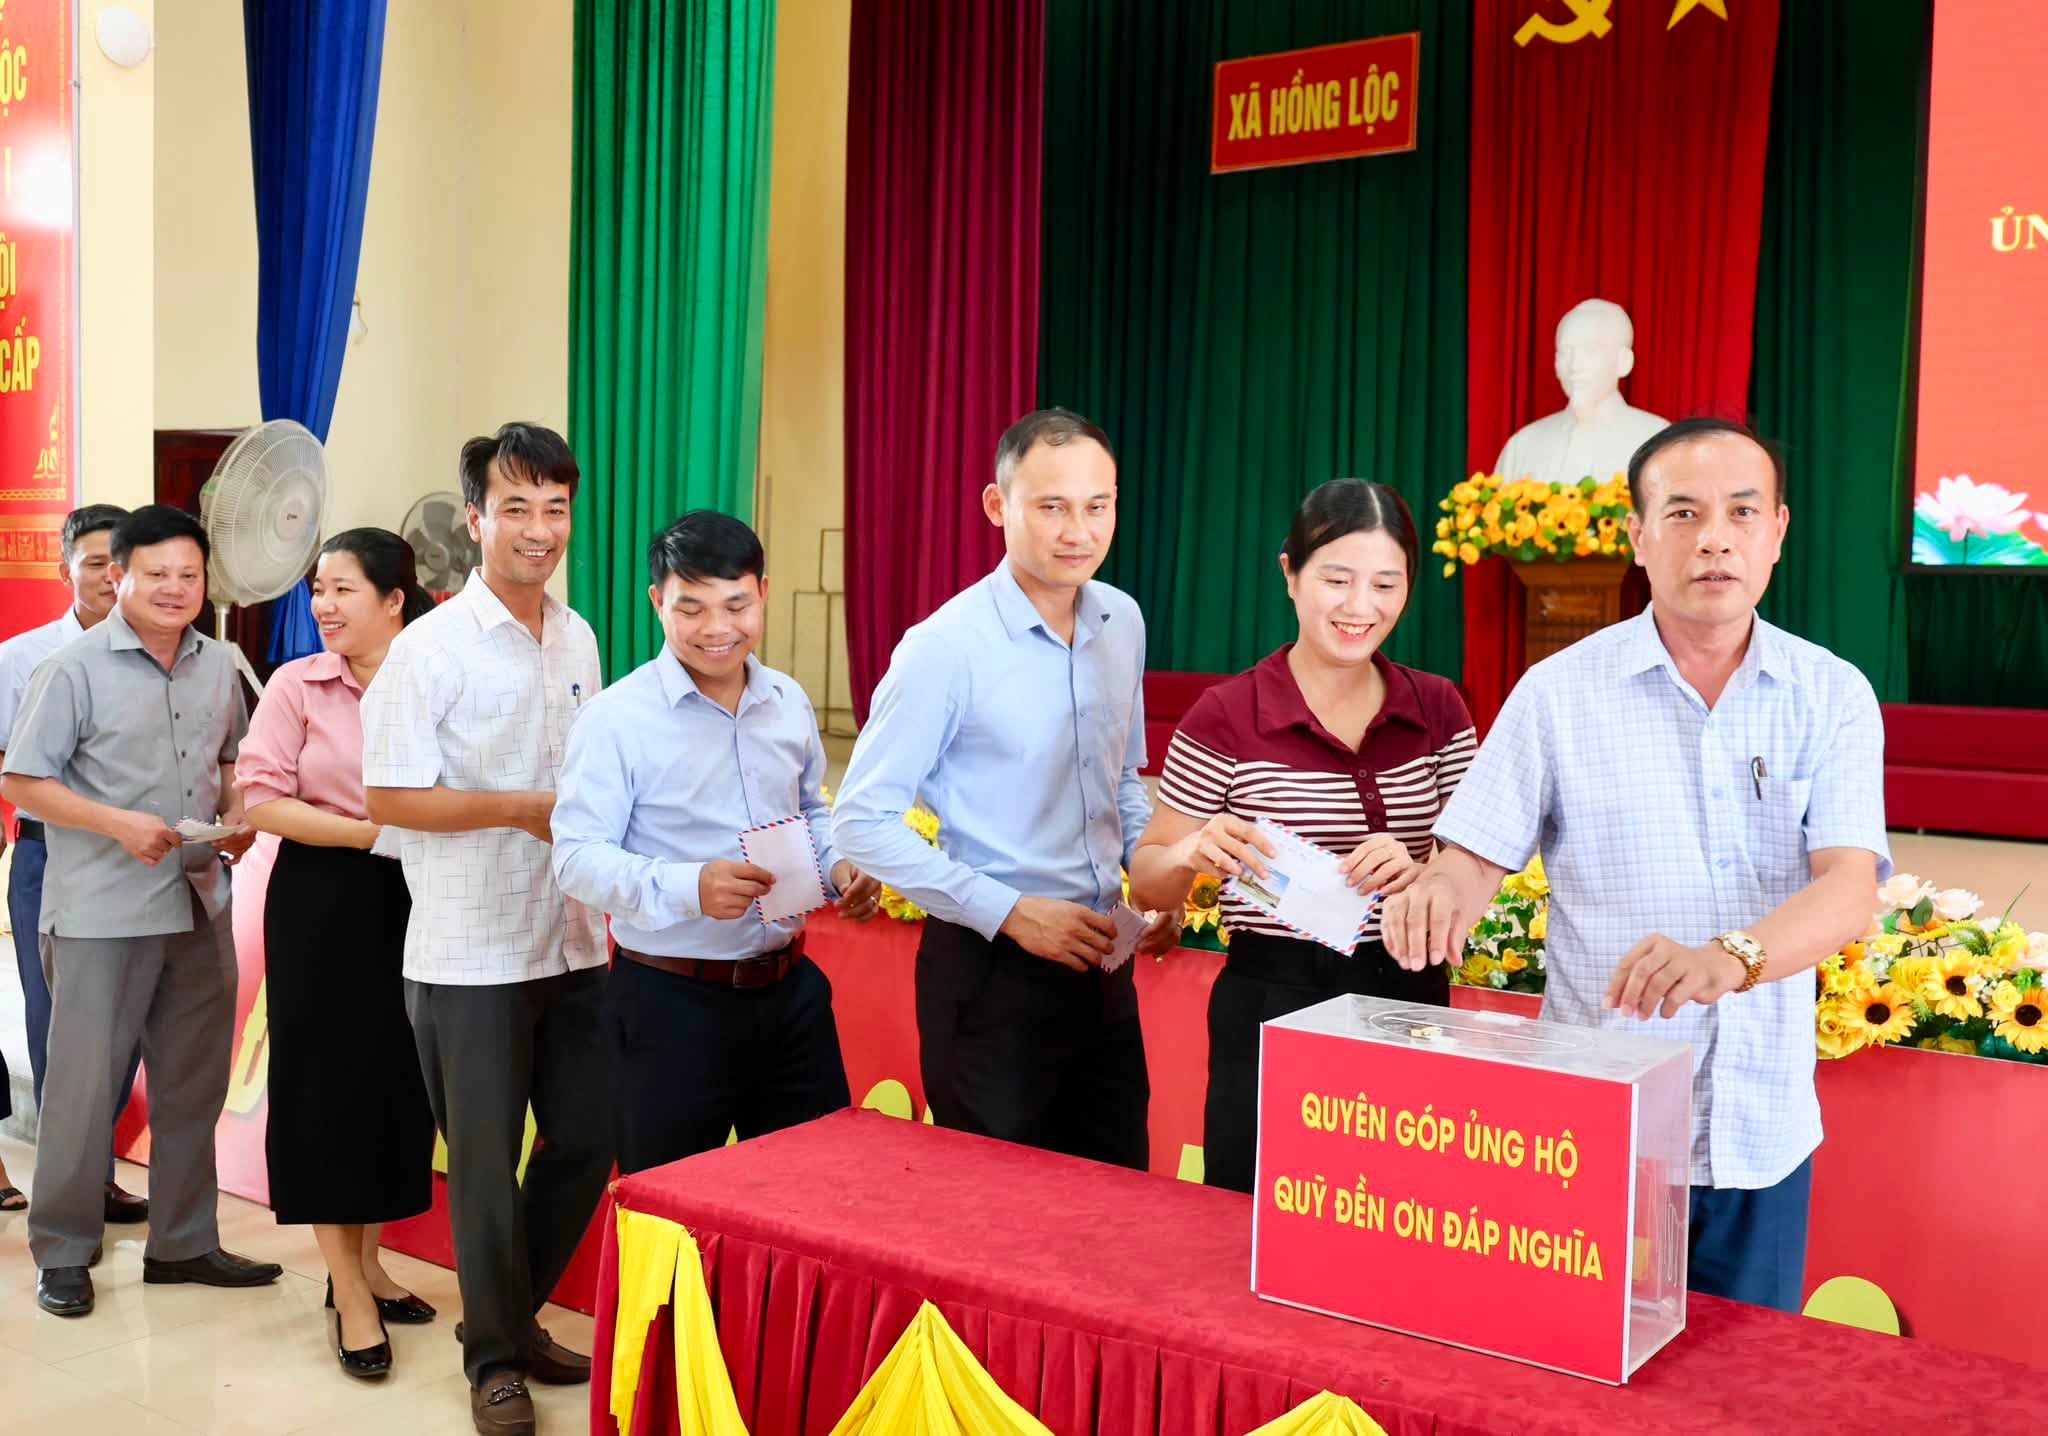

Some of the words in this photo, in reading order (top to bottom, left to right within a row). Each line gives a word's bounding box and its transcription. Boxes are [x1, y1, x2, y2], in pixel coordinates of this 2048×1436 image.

[1229, 83, 1261, 140] XÃ
[1270, 68, 1340, 135] HỒNG
[1349, 64, 1399, 134] LỘC
[0, 318, 41, 392] CẤP
[1302, 1093, 1386, 1141] QUYÊN
[1396, 1104, 1455, 1152] GÓP
[1464, 1110, 1524, 1167] ỦNG
[1535, 1130, 1577, 1188] HỘ
[1275, 1175, 1327, 1217] QUỸ
[1335, 1174, 1384, 1231] ĐỀN
[1394, 1199, 1433, 1242] ƠN
[1443, 1206, 1500, 1255] ĐÁP
[1509, 1226, 1602, 1280] NGHĨA
